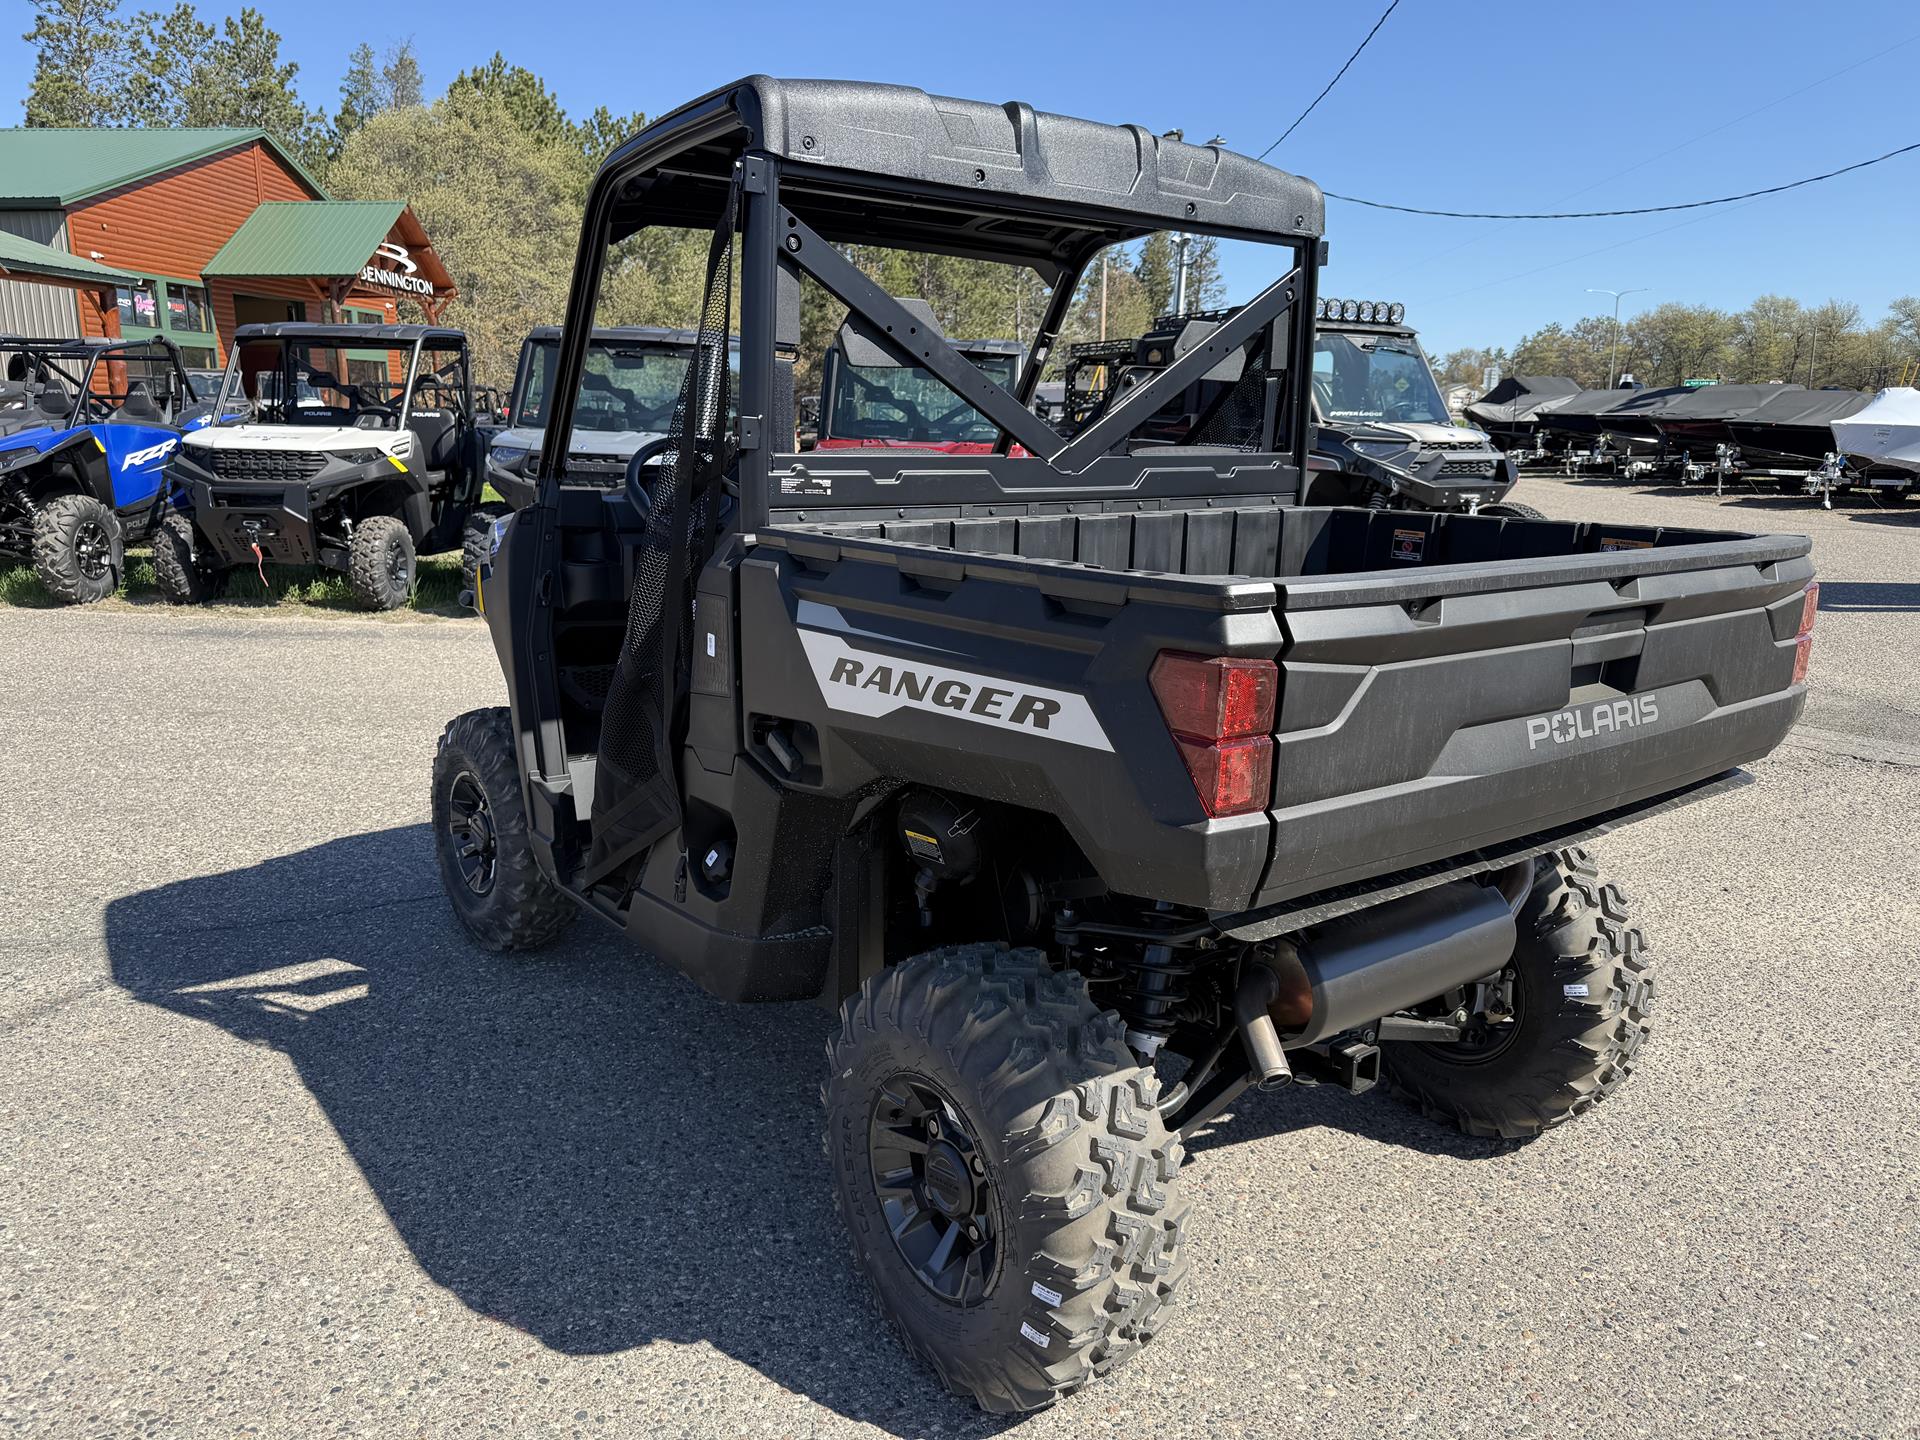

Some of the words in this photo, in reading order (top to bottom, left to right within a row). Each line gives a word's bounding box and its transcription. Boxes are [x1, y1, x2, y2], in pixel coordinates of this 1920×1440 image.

[121, 438, 178, 472] RZR
[225, 459, 298, 472] POLARIS
[829, 656, 1061, 731] RANGER
[1526, 694, 1659, 750] POLARIS
[843, 1115, 871, 1234] CARLSTAR
